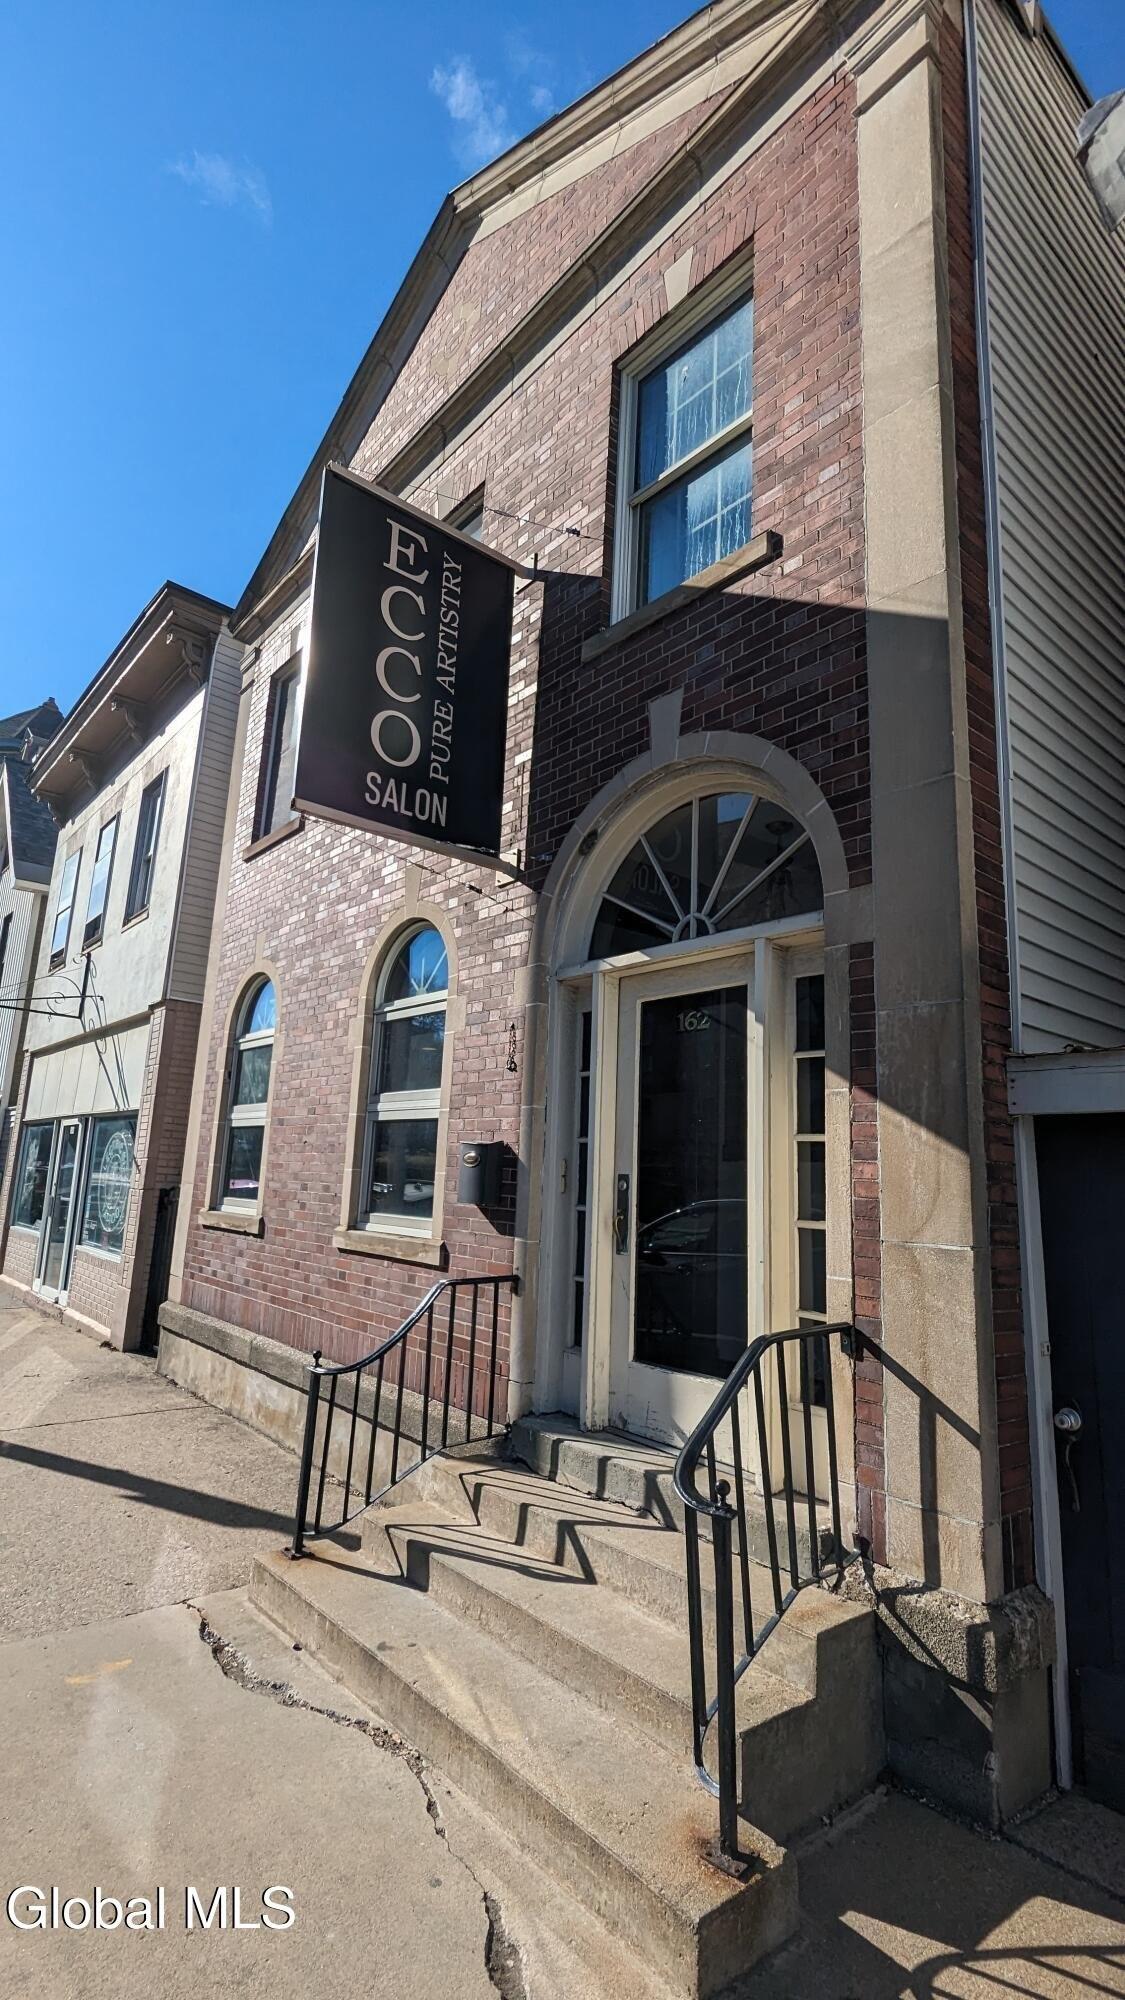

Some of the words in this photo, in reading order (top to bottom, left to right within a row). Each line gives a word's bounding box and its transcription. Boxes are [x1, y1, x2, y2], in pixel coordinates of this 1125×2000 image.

[370, 517, 430, 768] ECCO
[436, 551, 463, 695] ARTISTRY
[430, 699, 455, 785] PURE
[364, 771, 448, 827] SALON
[676, 1009, 711, 1032] 162
